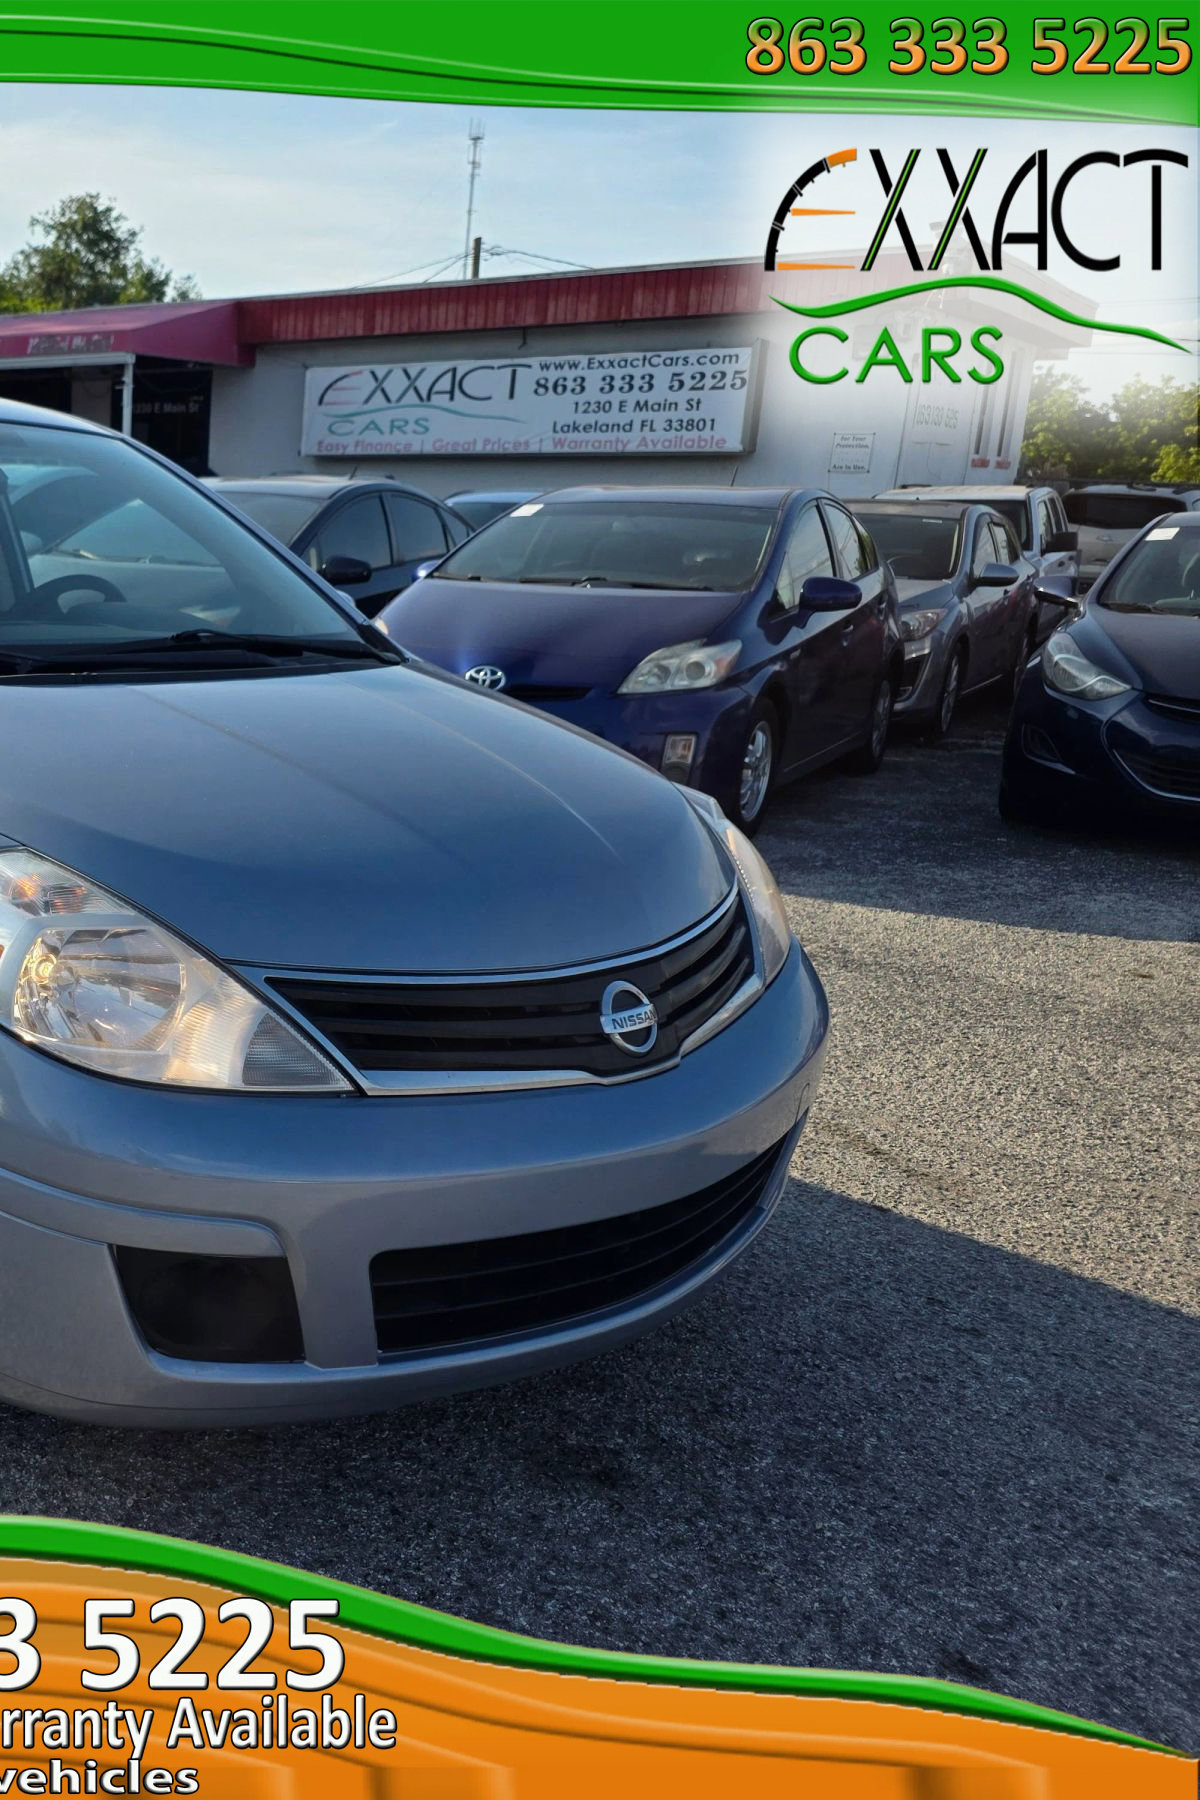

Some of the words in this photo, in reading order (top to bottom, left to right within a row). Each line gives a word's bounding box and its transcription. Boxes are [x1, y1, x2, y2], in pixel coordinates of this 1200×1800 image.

[539, 354, 739, 371] www.ExxactCars.com
[318, 363, 532, 405] EXXACT
[533, 376, 586, 396] 863
[599, 373, 655, 394] 333
[668, 369, 747, 392] 5225
[573, 401, 612, 414] 1230
[618, 400, 628, 413] E
[633, 399, 678, 413] Main
[685, 398, 702, 411] St
[327, 418, 430, 436] CARS
[552, 420, 634, 434] Lakeland
[640, 420, 657, 432] FL
[663, 418, 716, 432] 33801
[317, 440, 351, 454] Easy
[354, 440, 412, 452] Finance
[432, 439, 476, 451] Great
[483, 438, 530, 451] Prices
[552, 436, 630, 452] Warranty
[636, 434, 727, 449] Available
[612, 1009, 657, 1030] NISSAN
